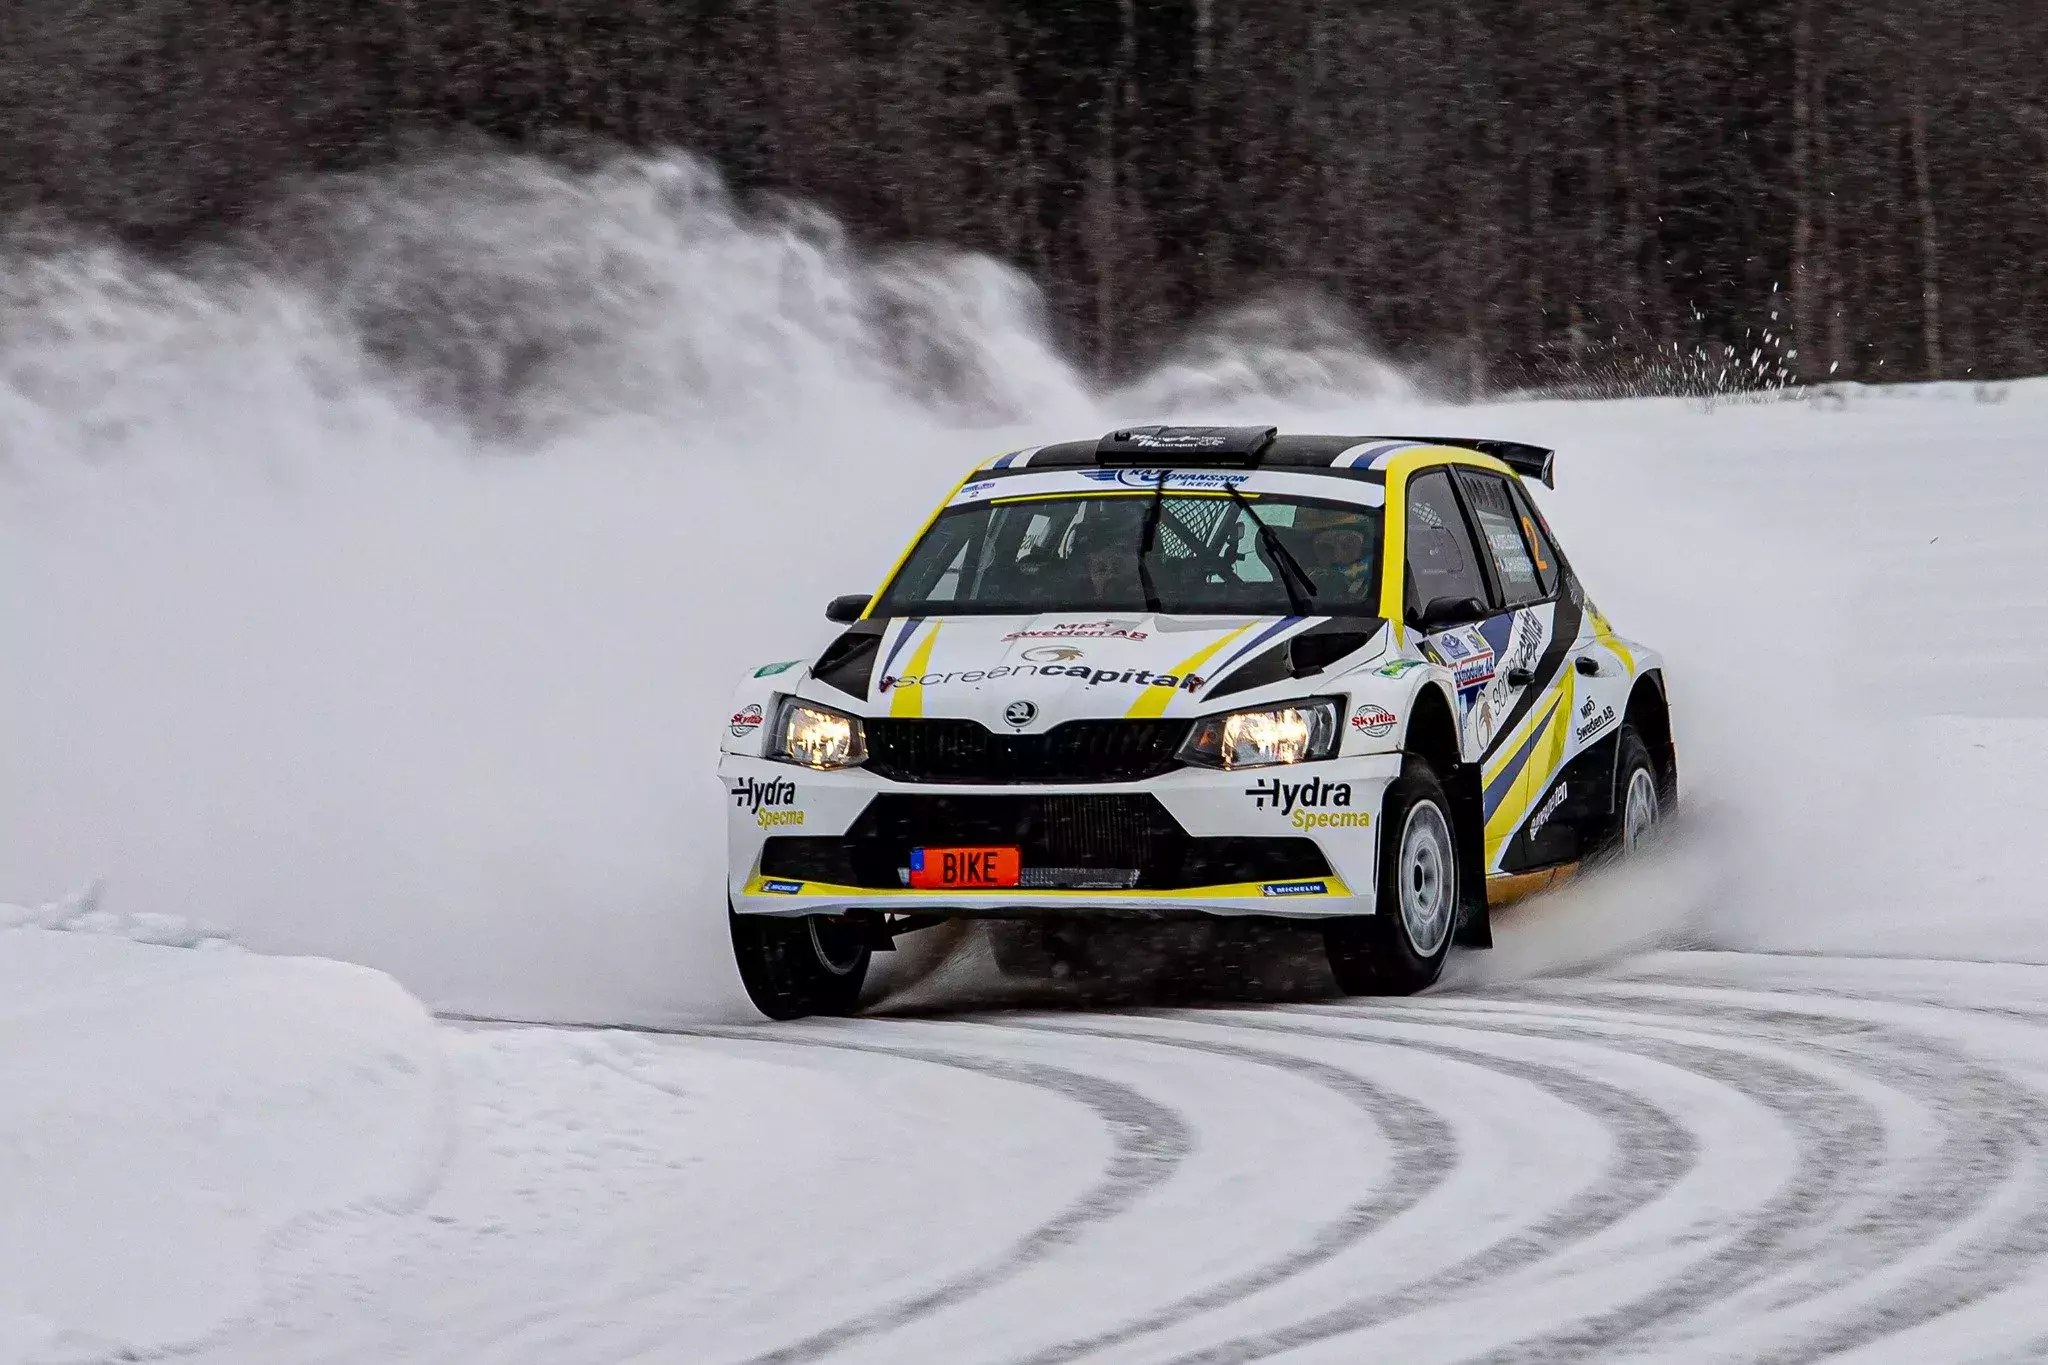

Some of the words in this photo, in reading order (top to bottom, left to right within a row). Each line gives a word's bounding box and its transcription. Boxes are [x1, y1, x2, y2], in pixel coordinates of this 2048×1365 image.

[1521, 515, 1548, 571] 2
[1110, 629, 1148, 640] AB
[891, 664, 1197, 689] screencapital
[1351, 713, 1397, 727] Skyltia
[1576, 715, 1605, 740] Sweden
[1602, 705, 1615, 722] AB
[731, 775, 796, 814] Hydra
[1245, 776, 1352, 816] Hydra
[757, 807, 805, 830] Specma
[1291, 808, 1372, 832] Specma
[942, 852, 998, 884] BIKE
[1276, 884, 1321, 893] MICHELIN
